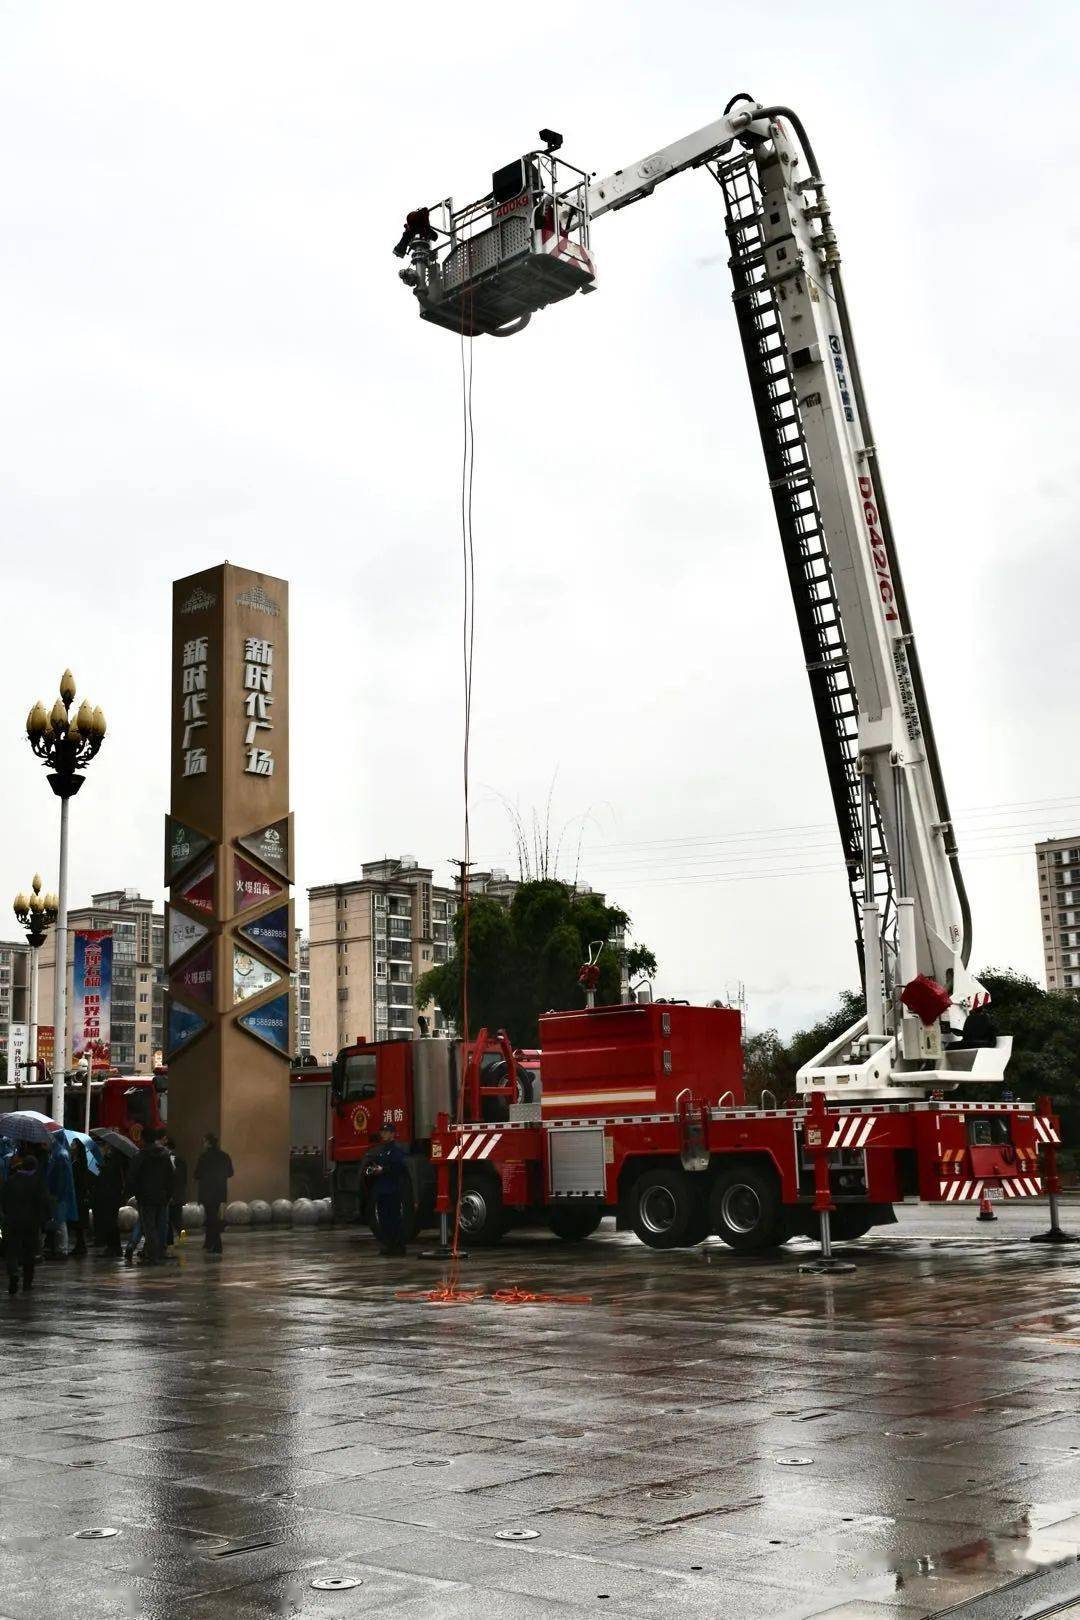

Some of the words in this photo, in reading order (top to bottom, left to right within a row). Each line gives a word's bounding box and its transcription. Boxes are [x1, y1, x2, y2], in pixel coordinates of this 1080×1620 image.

[834, 356, 855, 422] 徐工集团
[858, 476, 898, 621] DG42/C1
[182, 636, 208, 777] 新时代广场
[244, 637, 274, 777] 新时代广场
[236, 880, 270, 895] 火爆招商
[383, 1109, 403, 1123] 消防
